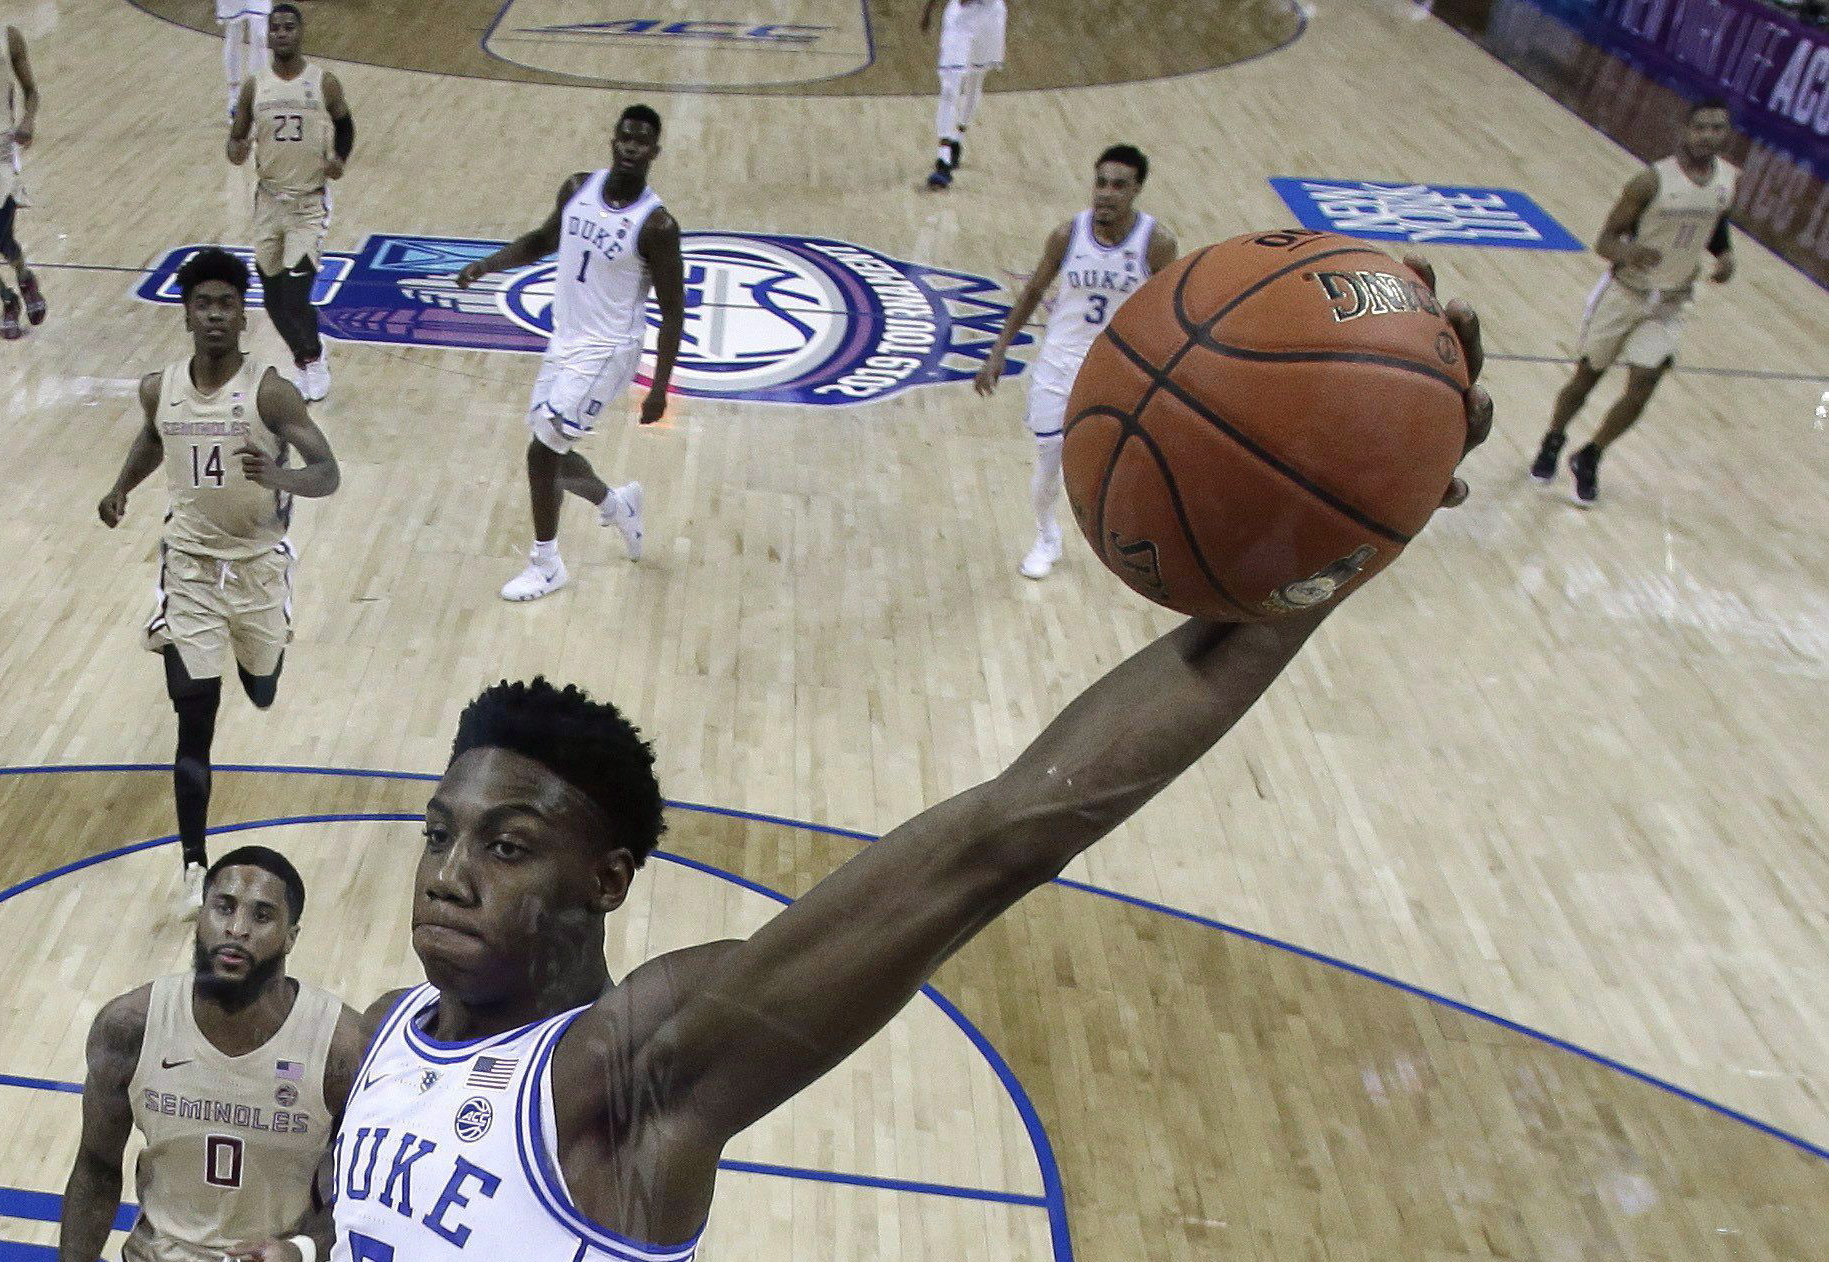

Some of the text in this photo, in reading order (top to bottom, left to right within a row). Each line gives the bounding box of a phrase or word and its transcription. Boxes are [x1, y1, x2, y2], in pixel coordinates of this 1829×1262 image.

[273, 114, 303, 142] 23
[569, 216, 623, 261] DUKE
[577, 250, 591, 283] 1
[1068, 269, 1138, 293] DUKE
[803, 241, 937, 398] 2019 TOURNAMENT
[1084, 294, 1109, 324] 3
[190, 444, 226, 488] 14
[142, 1087, 310, 1134] SEMINOLES
[205, 1133, 245, 1190] 0
